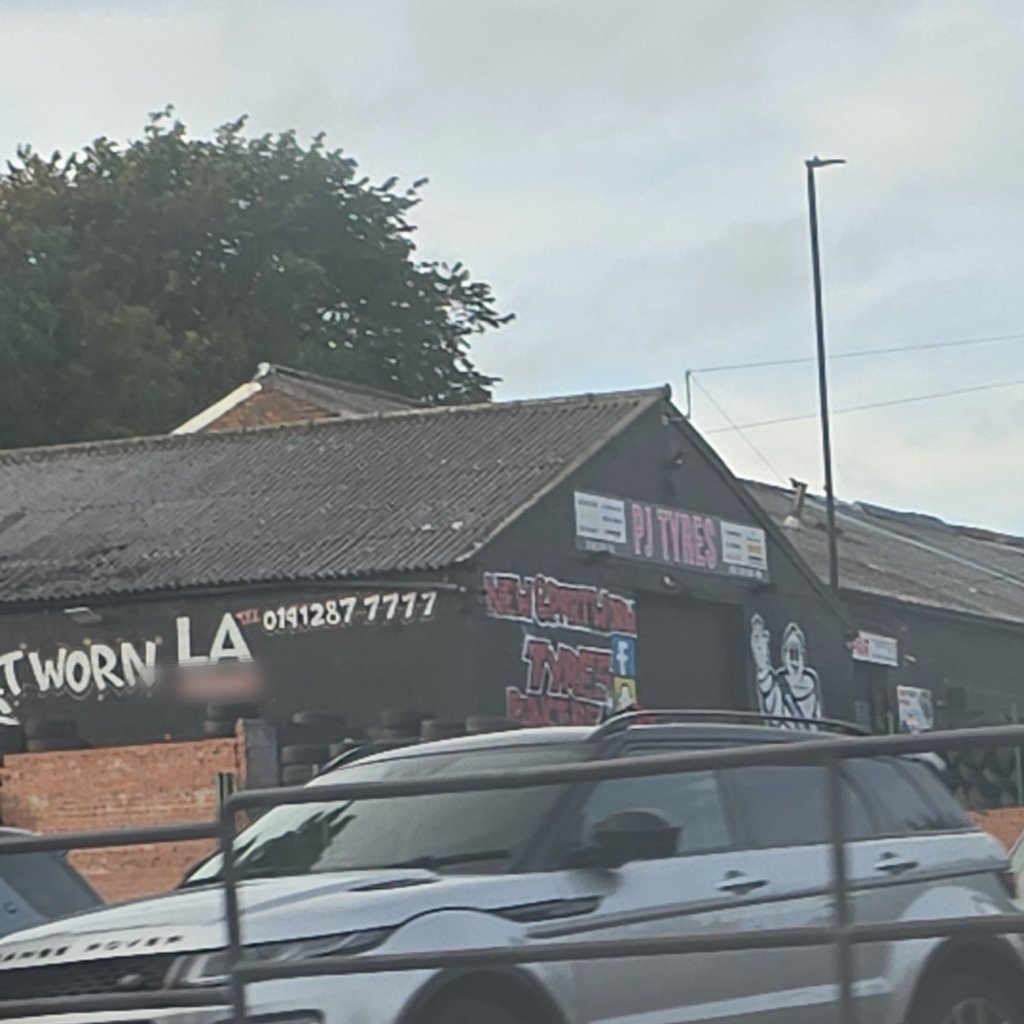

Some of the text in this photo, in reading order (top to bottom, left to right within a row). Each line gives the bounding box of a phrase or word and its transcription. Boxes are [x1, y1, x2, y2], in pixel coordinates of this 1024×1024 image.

[631, 503, 718, 569] PJ TYRES
[28, 640, 157, 695] WORN
[175, 612, 254, 667] LA
